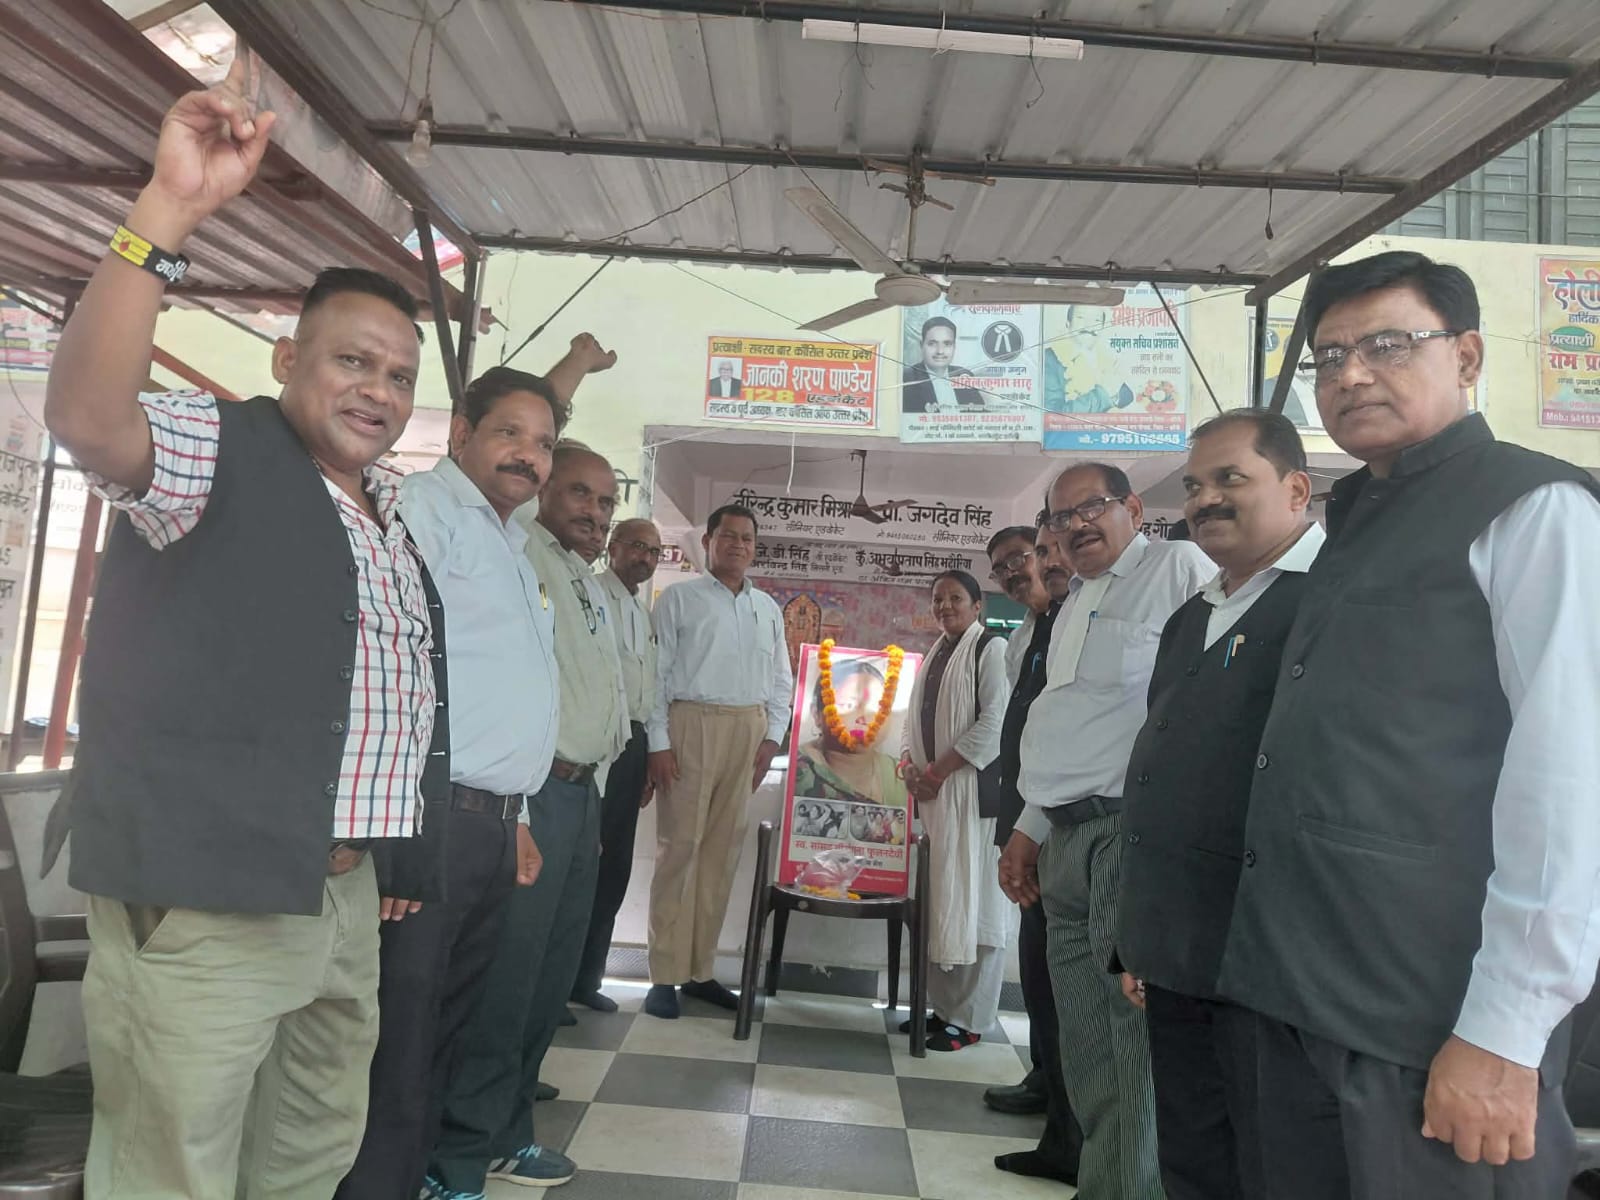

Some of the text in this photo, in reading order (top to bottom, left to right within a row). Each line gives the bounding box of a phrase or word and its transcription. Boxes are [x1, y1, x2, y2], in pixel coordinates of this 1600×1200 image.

[1133, 334, 1152, 349] सचिव
[1549, 333, 1594, 347] प्रत्याशी
[749, 343, 775, 355] सदस्य
[777, 343, 791, 355] बार
[826, 347, 851, 360] उत्तर
[743, 360, 873, 393] जानकी शरण पाण्डेय
[743, 388, 795, 403] 128
[777, 497, 819, 520] कुमार
[820, 494, 853, 520] मिश्रा
[907, 502, 962, 527] जगदेव
[963, 504, 993, 529] सिंह
[788, 544, 811, 561] सिंह
[923, 551, 940, 570] सिंह
